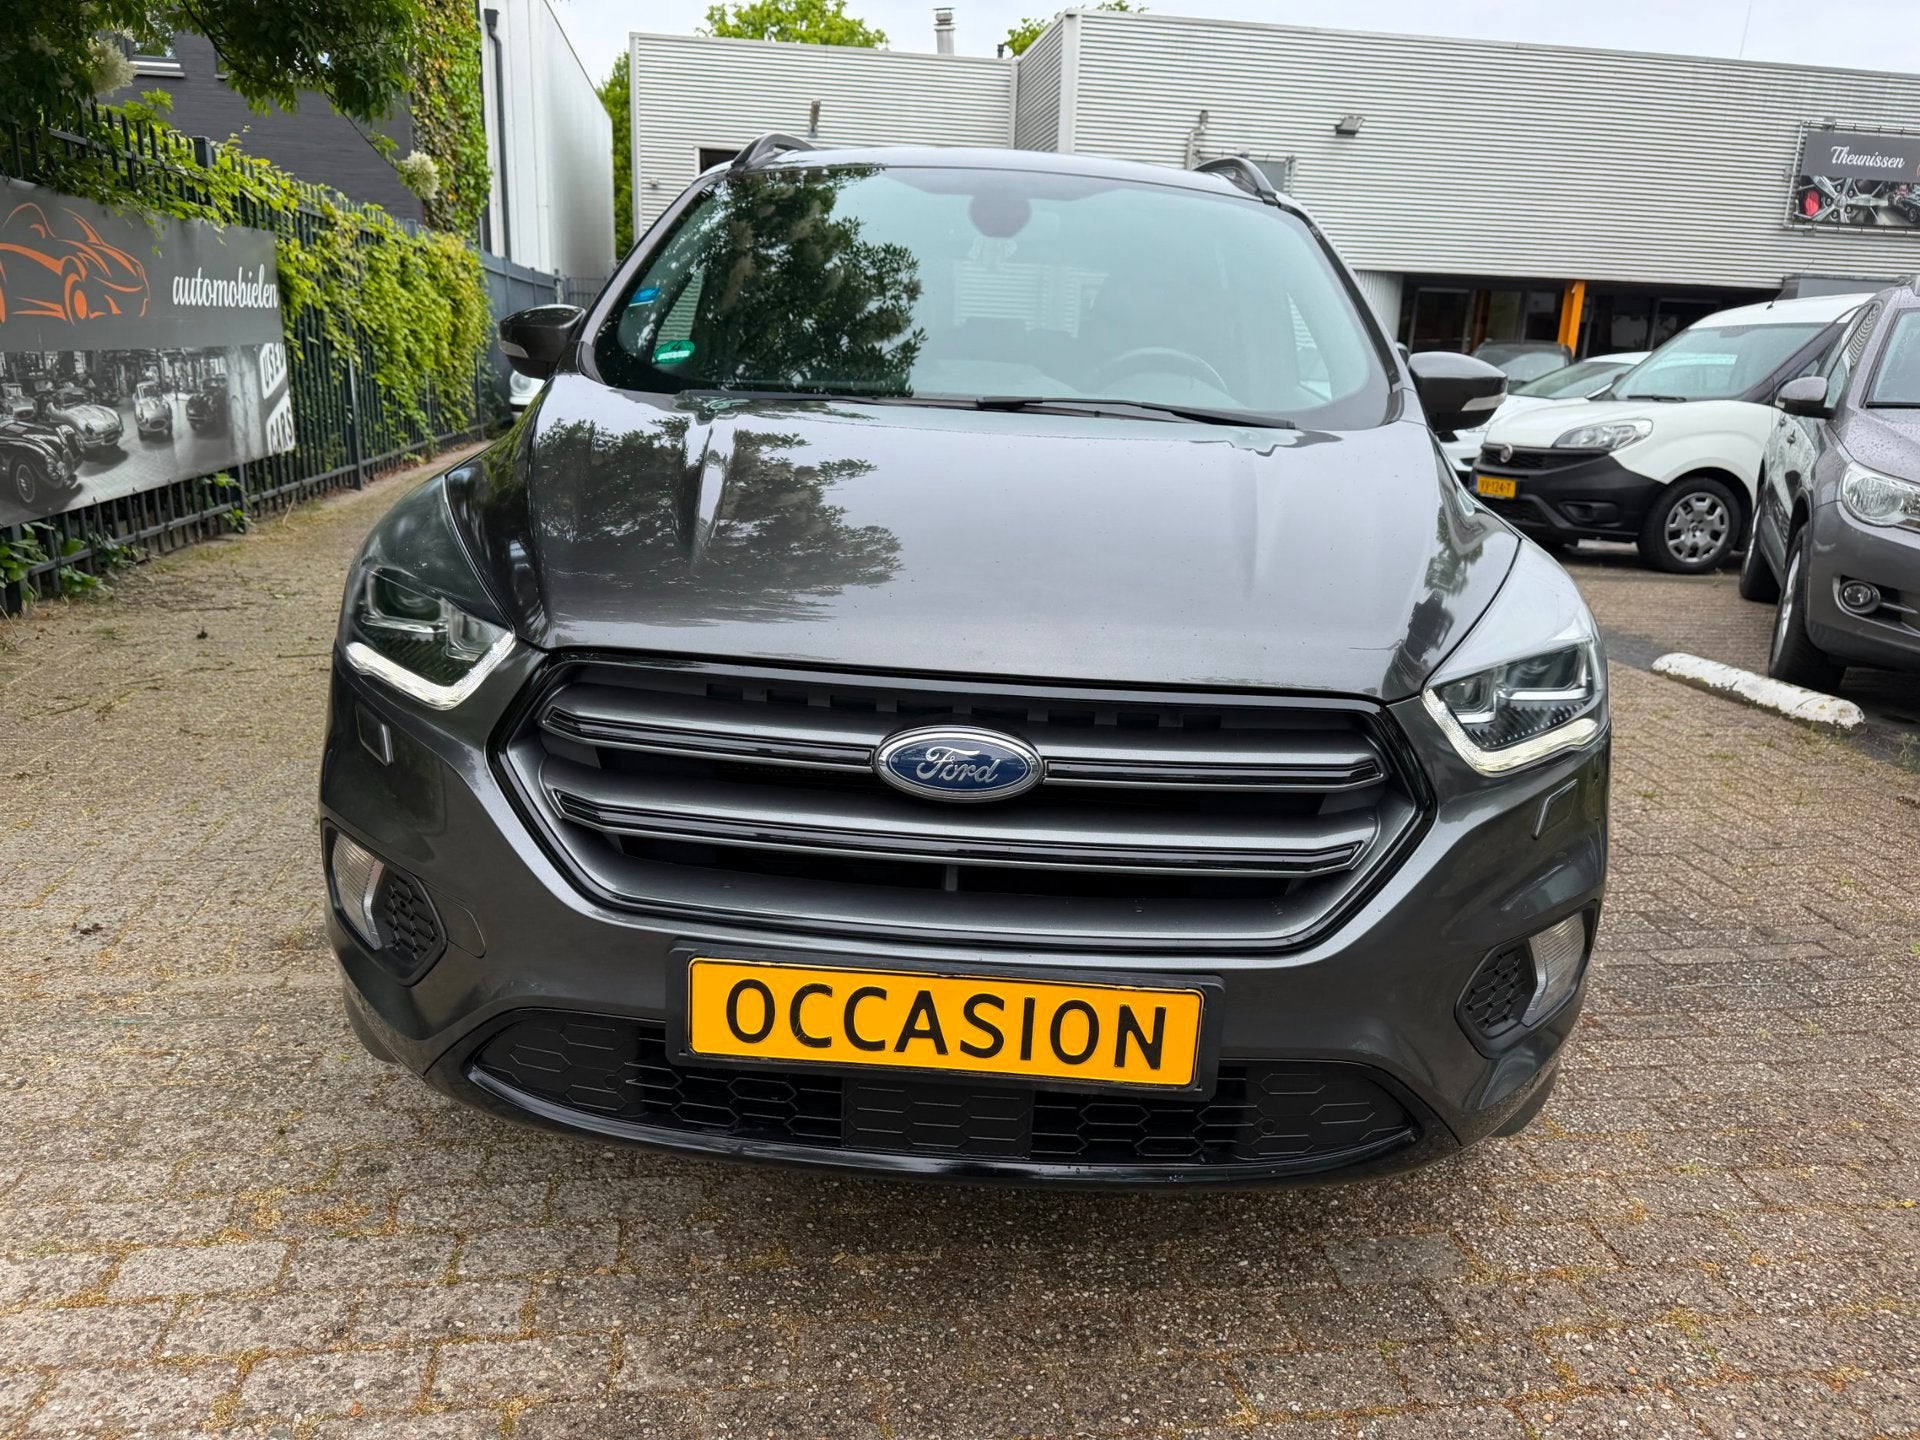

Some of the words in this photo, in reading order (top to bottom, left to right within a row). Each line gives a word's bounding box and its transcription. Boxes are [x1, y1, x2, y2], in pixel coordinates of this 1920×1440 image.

[1830, 145, 1905, 169] Theunissen
[173, 263, 279, 308] automobielen
[916, 746, 1000, 783] Ford
[726, 978, 1166, 1070] OCCASION
